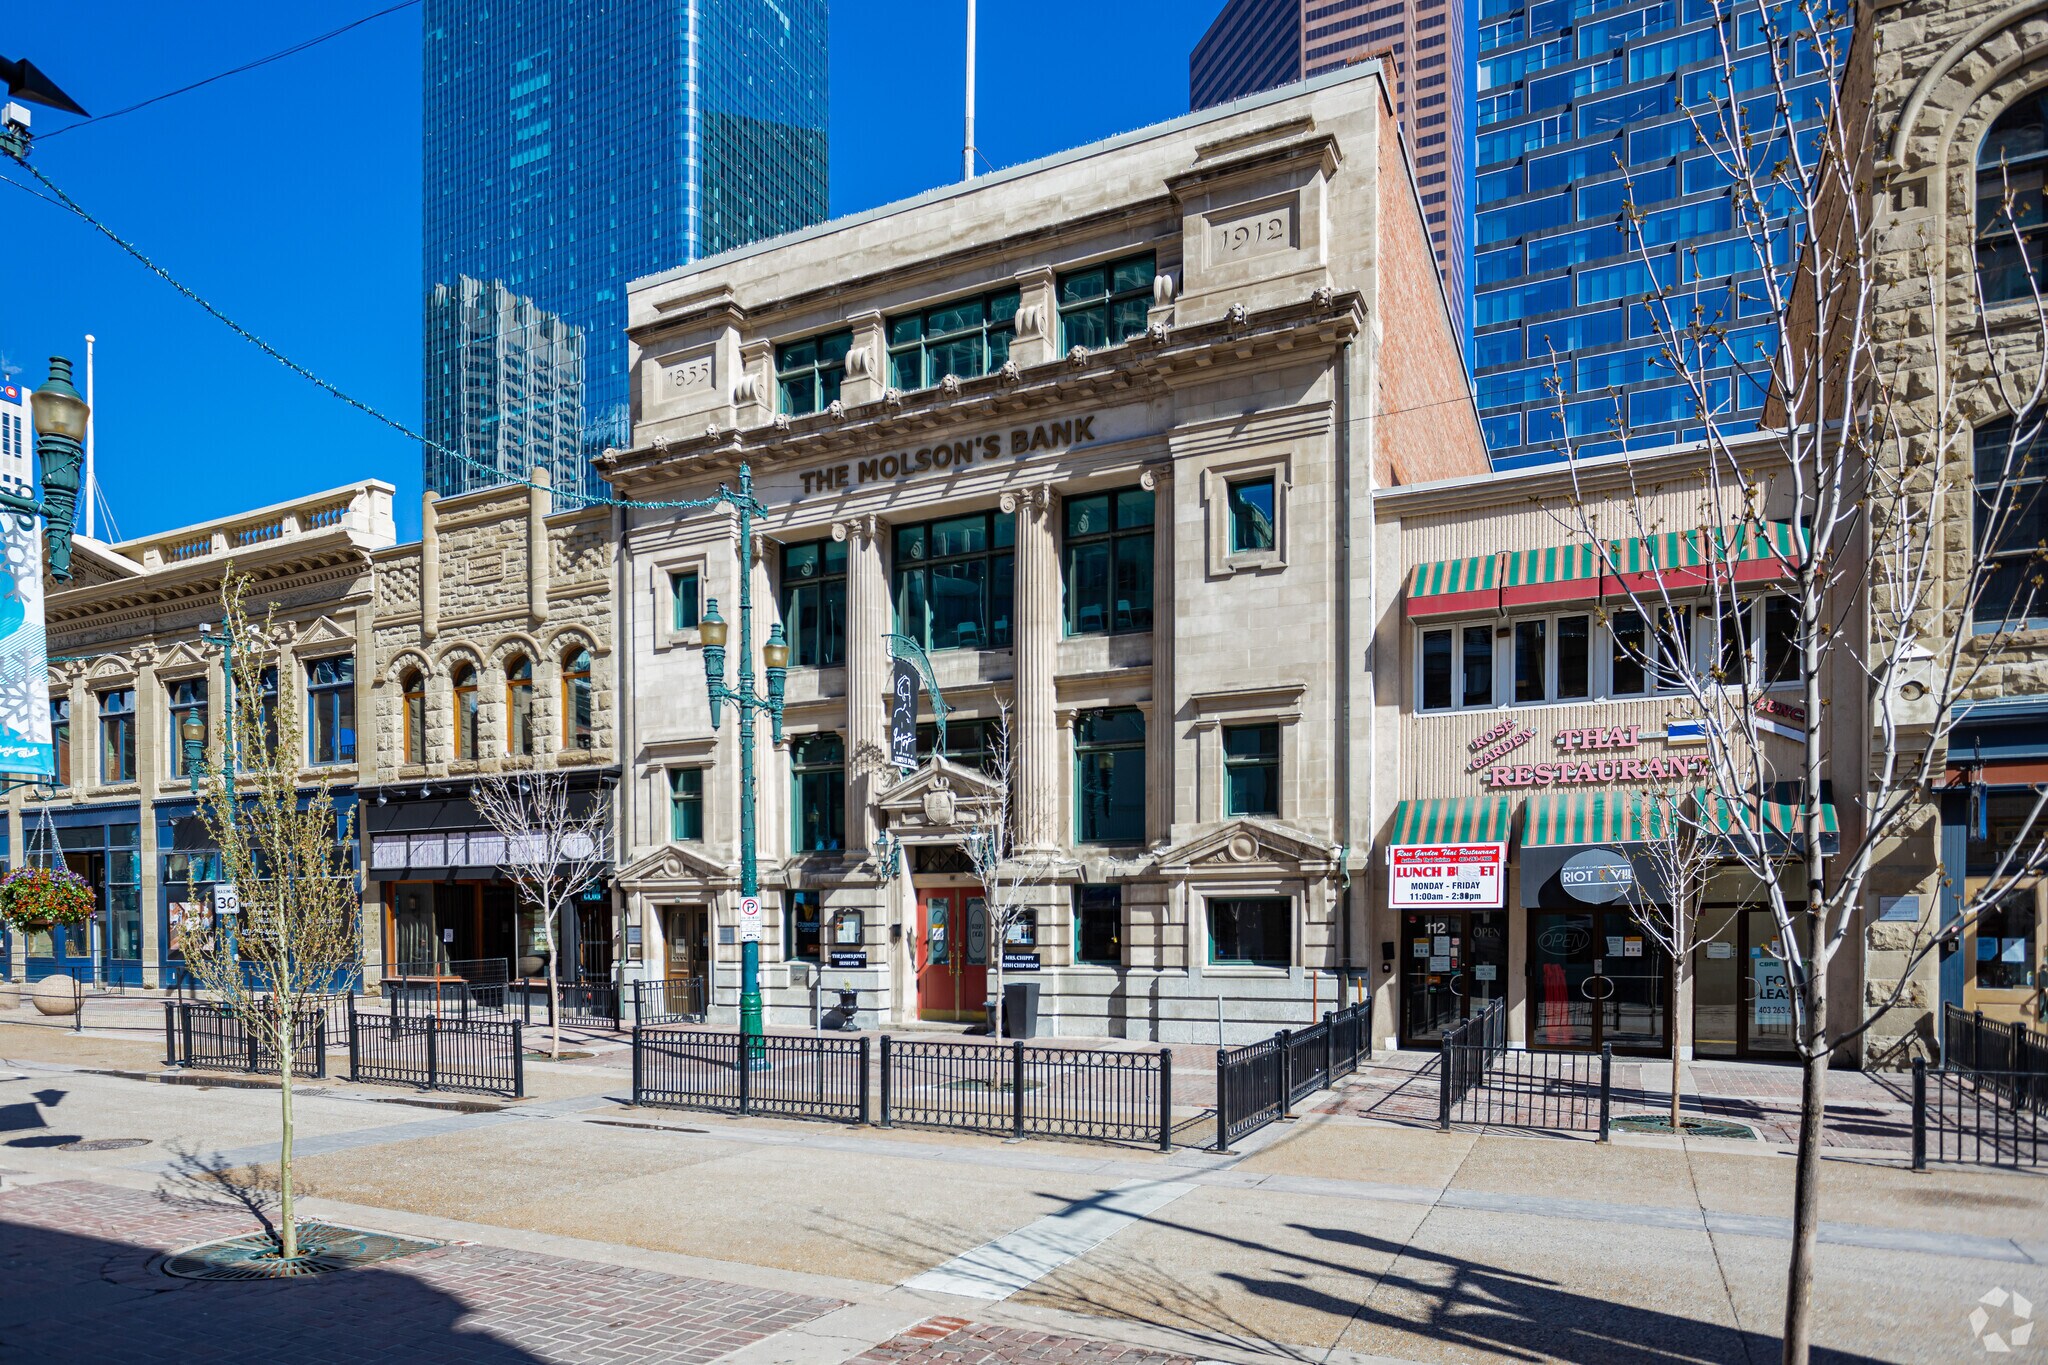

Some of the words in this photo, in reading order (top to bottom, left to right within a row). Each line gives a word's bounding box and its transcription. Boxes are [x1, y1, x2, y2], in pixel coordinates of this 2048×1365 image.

[1221, 218, 1283, 253] 1912
[668, 362, 709, 387] 1855
[799, 465, 850, 494] THE
[857, 435, 1001, 484] MOLSON'S
[1010, 415, 1096, 455] BANK
[1755, 697, 1805, 722] LUNC
[1474, 719, 1517, 750] ROSE
[1558, 724, 1641, 751] THAI
[1471, 727, 1535, 770] GARDEN
[1489, 754, 1710, 787] RESTAURANT
[1396, 849, 1413, 857] Rose
[1414, 849, 1439, 859] Garden
[1441, 848, 1457, 856] Thai
[1459, 847, 1497, 856] Restaurant
[1396, 866, 1442, 878] LUNCH
[1446, 865, 1496, 877] BET
[1563, 870, 1594, 883] RIOT
[1410, 882, 1444, 890] MONDAY
[1452, 881, 1481, 890] FRIDAY
[217, 896, 237, 909] 30
[1410, 892, 1444, 901] 11:00am
[1425, 922, 1446, 934] 112
[1473, 927, 1501, 938] OPEN
[1540, 933, 1586, 948] OPEN
[1765, 975, 1787, 987] FO
[1759, 1006, 1771, 1014] 403
[1773, 1006, 1786, 1014] 263
